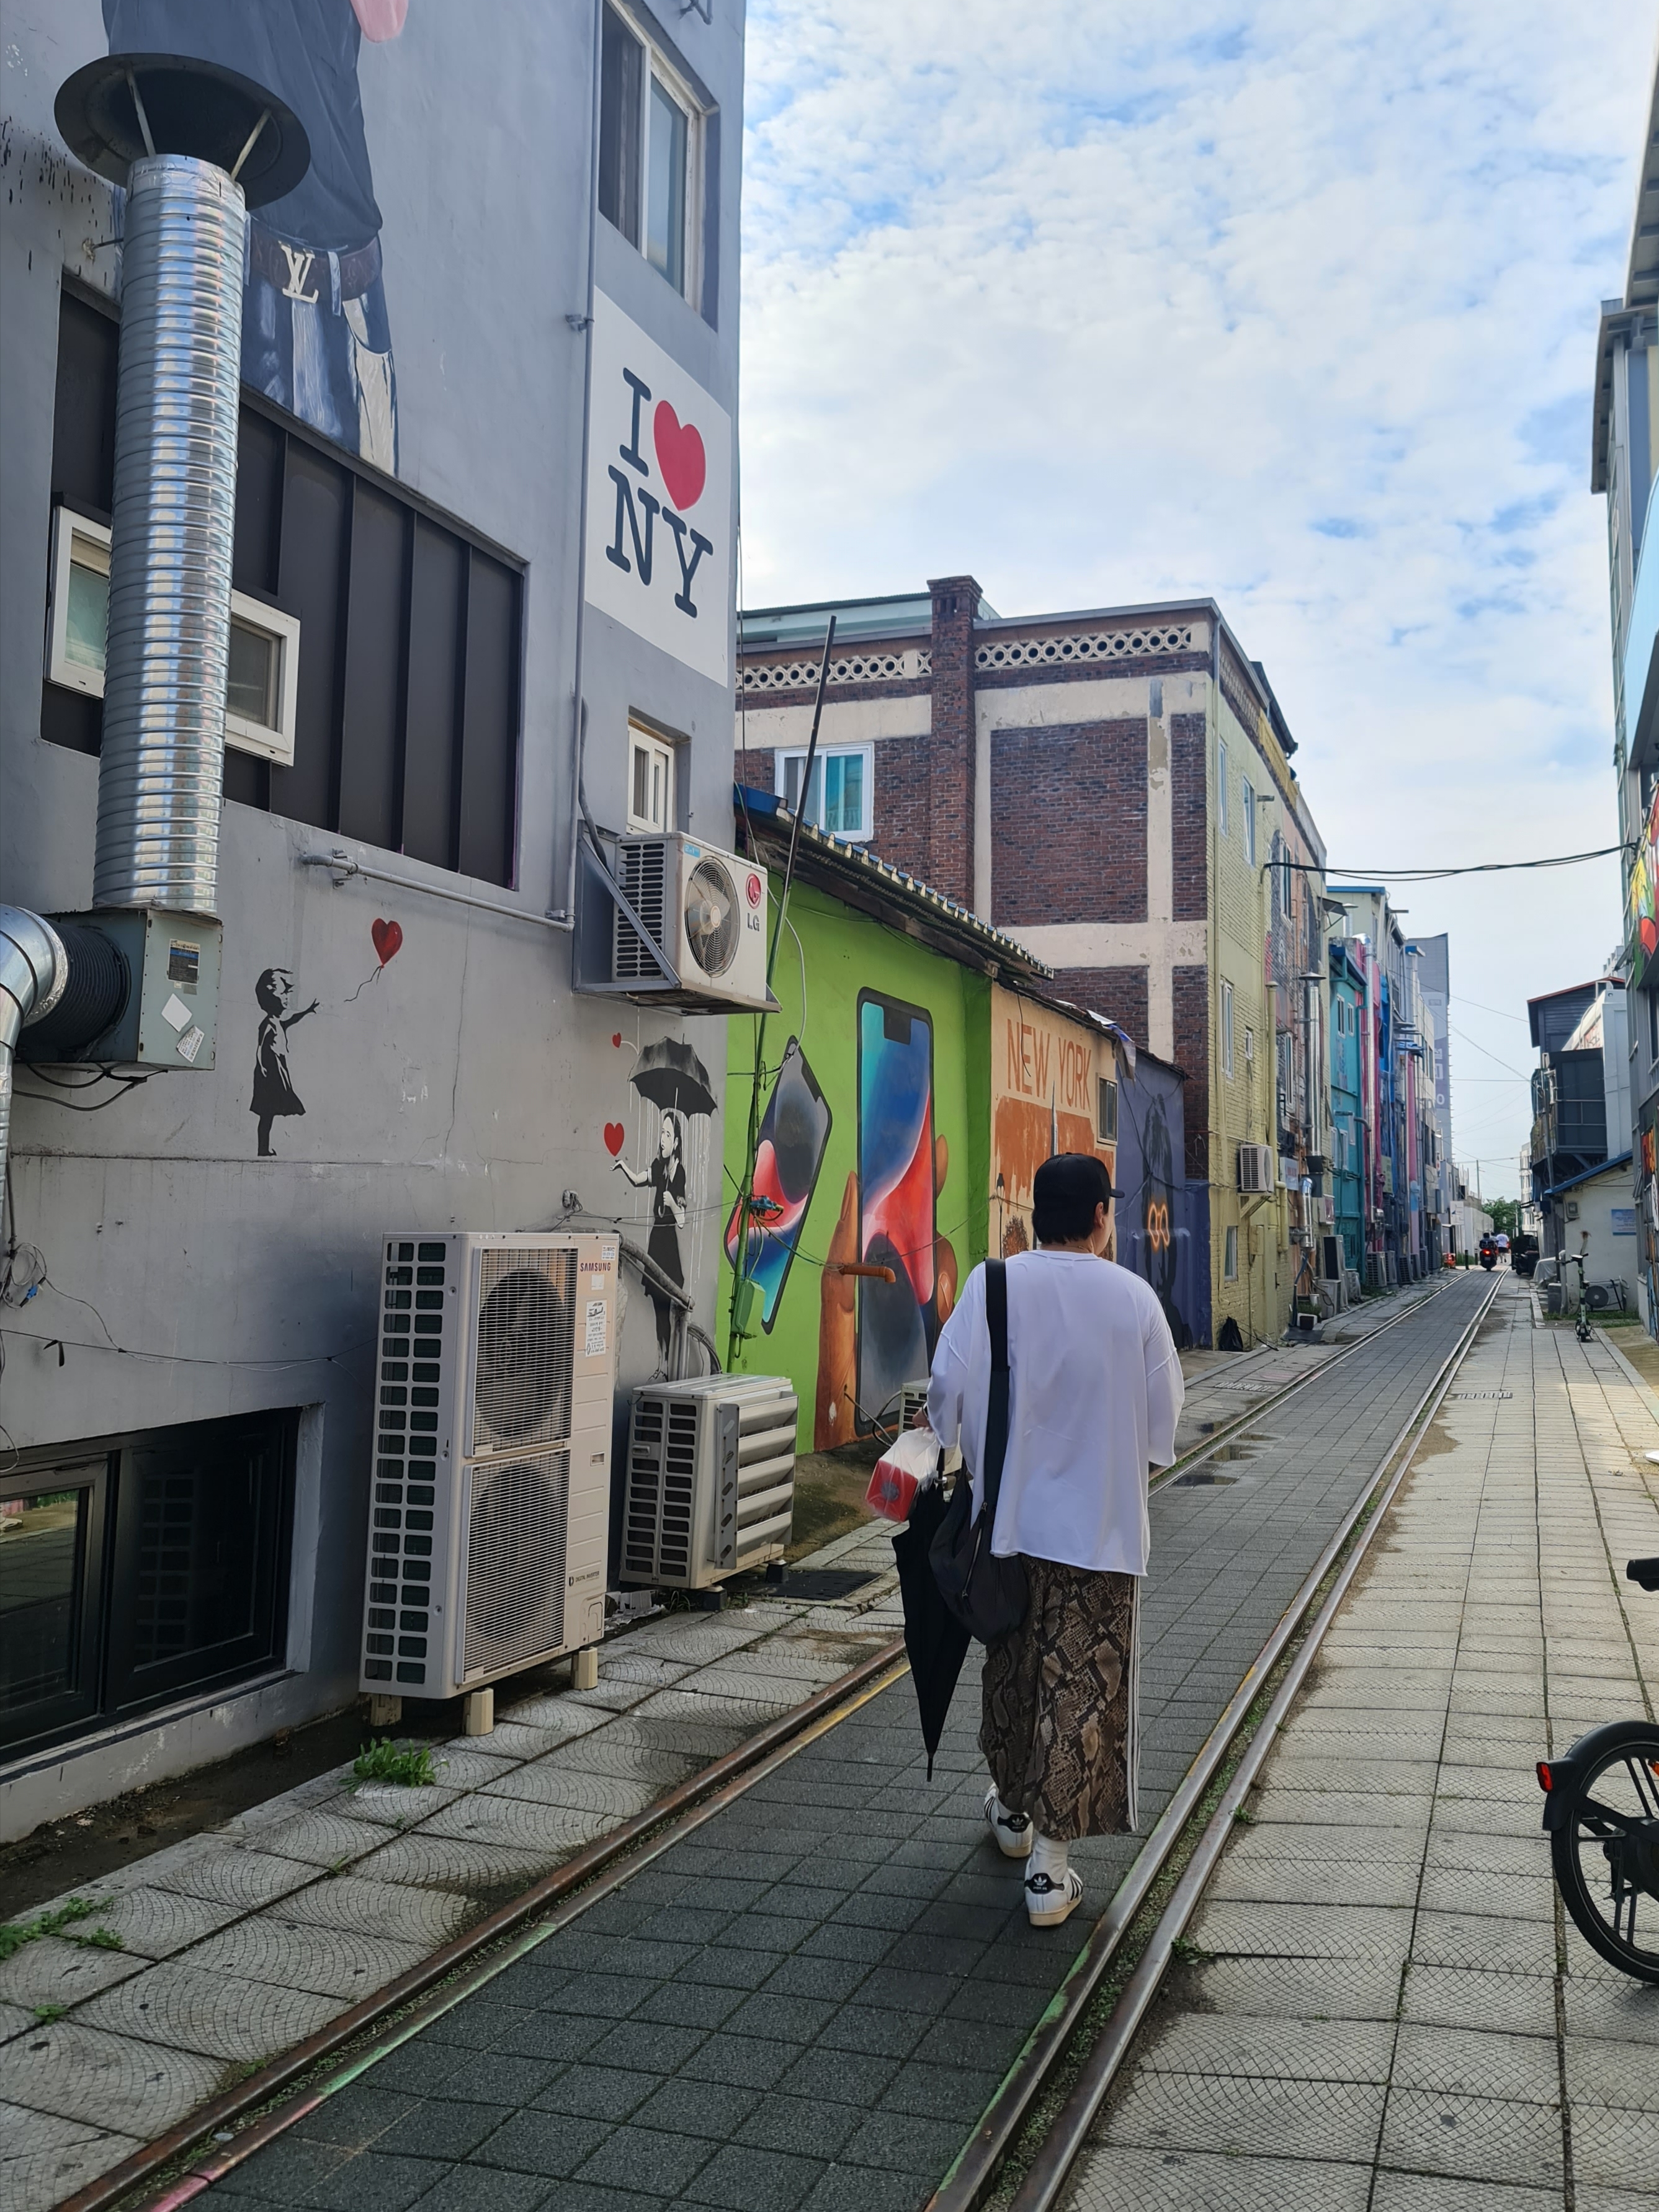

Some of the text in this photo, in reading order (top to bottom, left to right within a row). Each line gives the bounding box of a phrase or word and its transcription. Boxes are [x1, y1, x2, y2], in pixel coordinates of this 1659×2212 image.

[619, 367, 652, 476] I
[606, 464, 713, 619] NY
[747, 912, 760, 932] LG
[1007, 1018, 1091, 1112] NEW YORK
[580, 1262, 611, 1272] SAMSUNG
